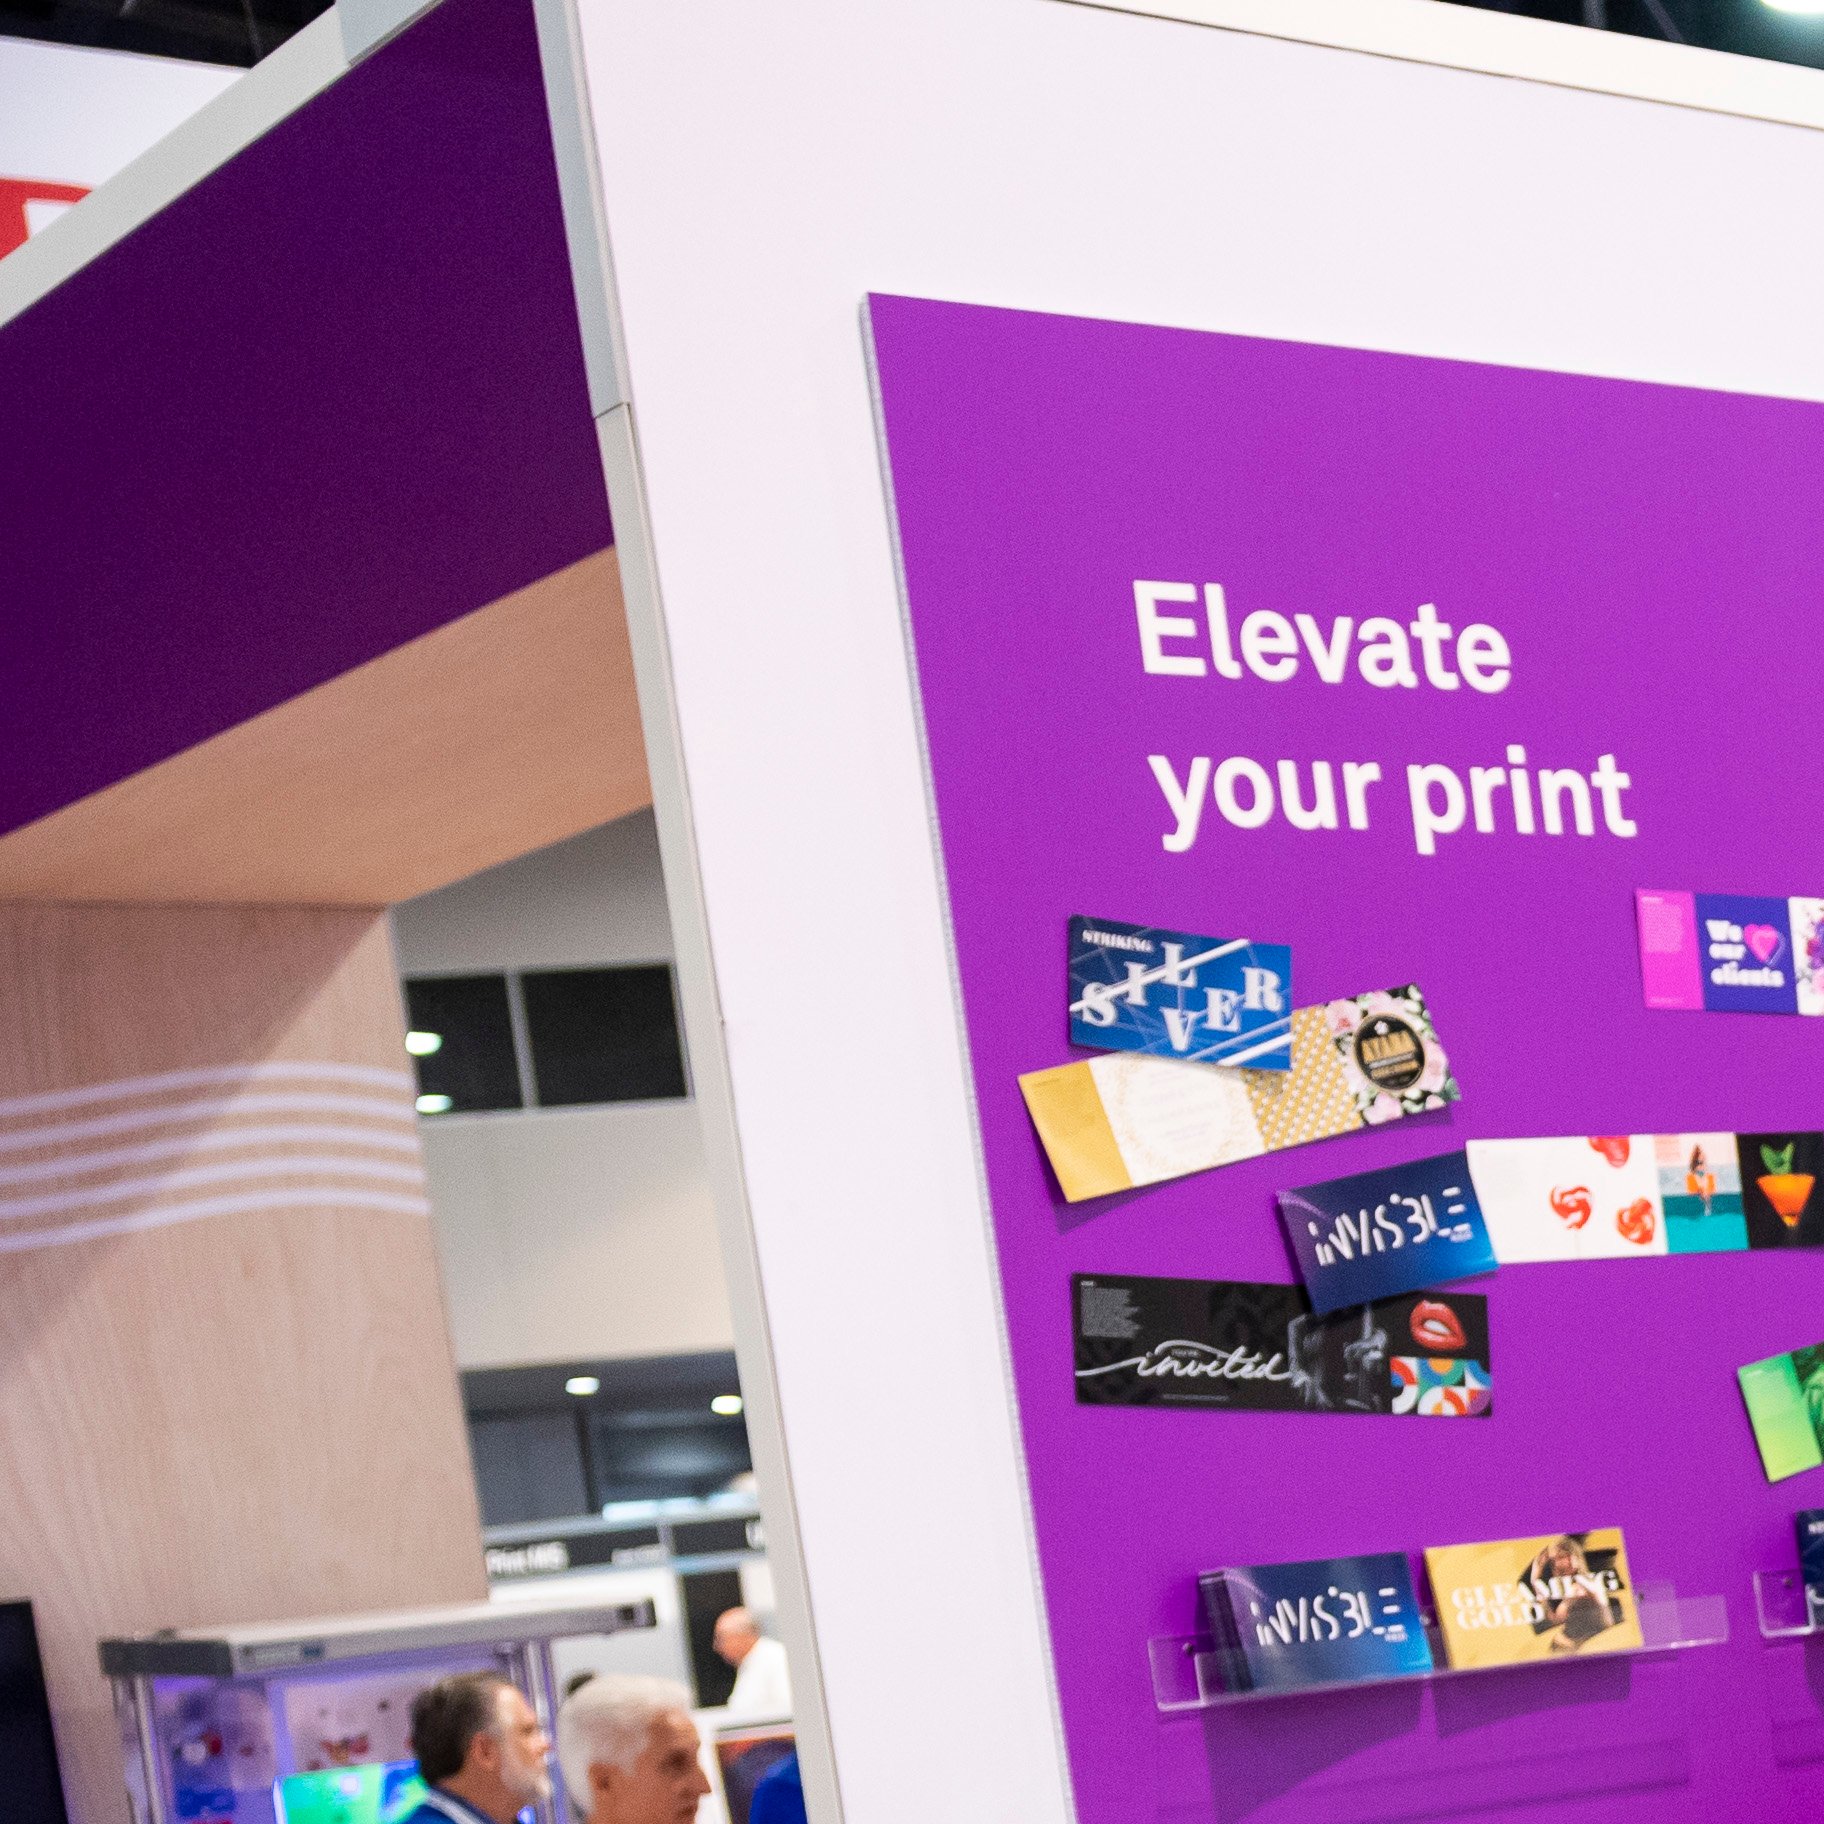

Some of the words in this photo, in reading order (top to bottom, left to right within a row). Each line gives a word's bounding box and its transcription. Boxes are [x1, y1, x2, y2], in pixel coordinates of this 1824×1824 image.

[1132, 579, 1512, 694] Elevate
[1146, 754, 1382, 853] your
[1406, 743, 1639, 856] print
[1081, 929, 1153, 953] STRIKING
[1449, 1570, 1621, 1611] GLEAMING
[1456, 1599, 1545, 1632] GOLD
